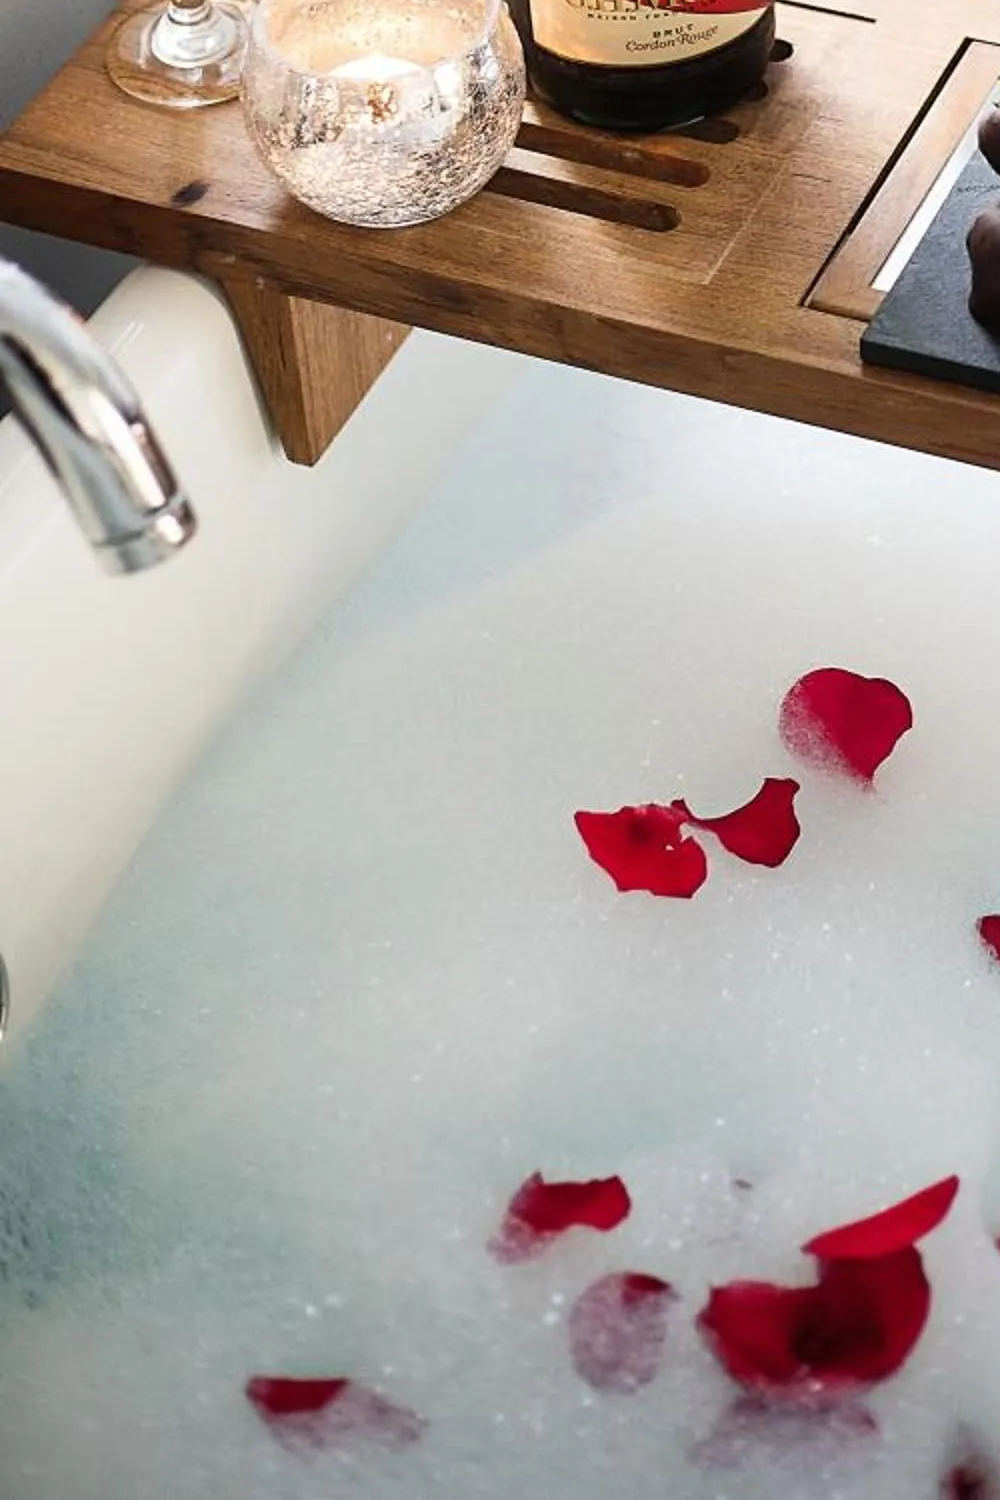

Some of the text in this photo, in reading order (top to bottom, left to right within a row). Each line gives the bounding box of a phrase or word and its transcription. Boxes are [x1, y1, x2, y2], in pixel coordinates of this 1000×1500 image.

[625, 25, 719, 52] Cordon Rouge
[652, 23, 694, 38] BRUT
